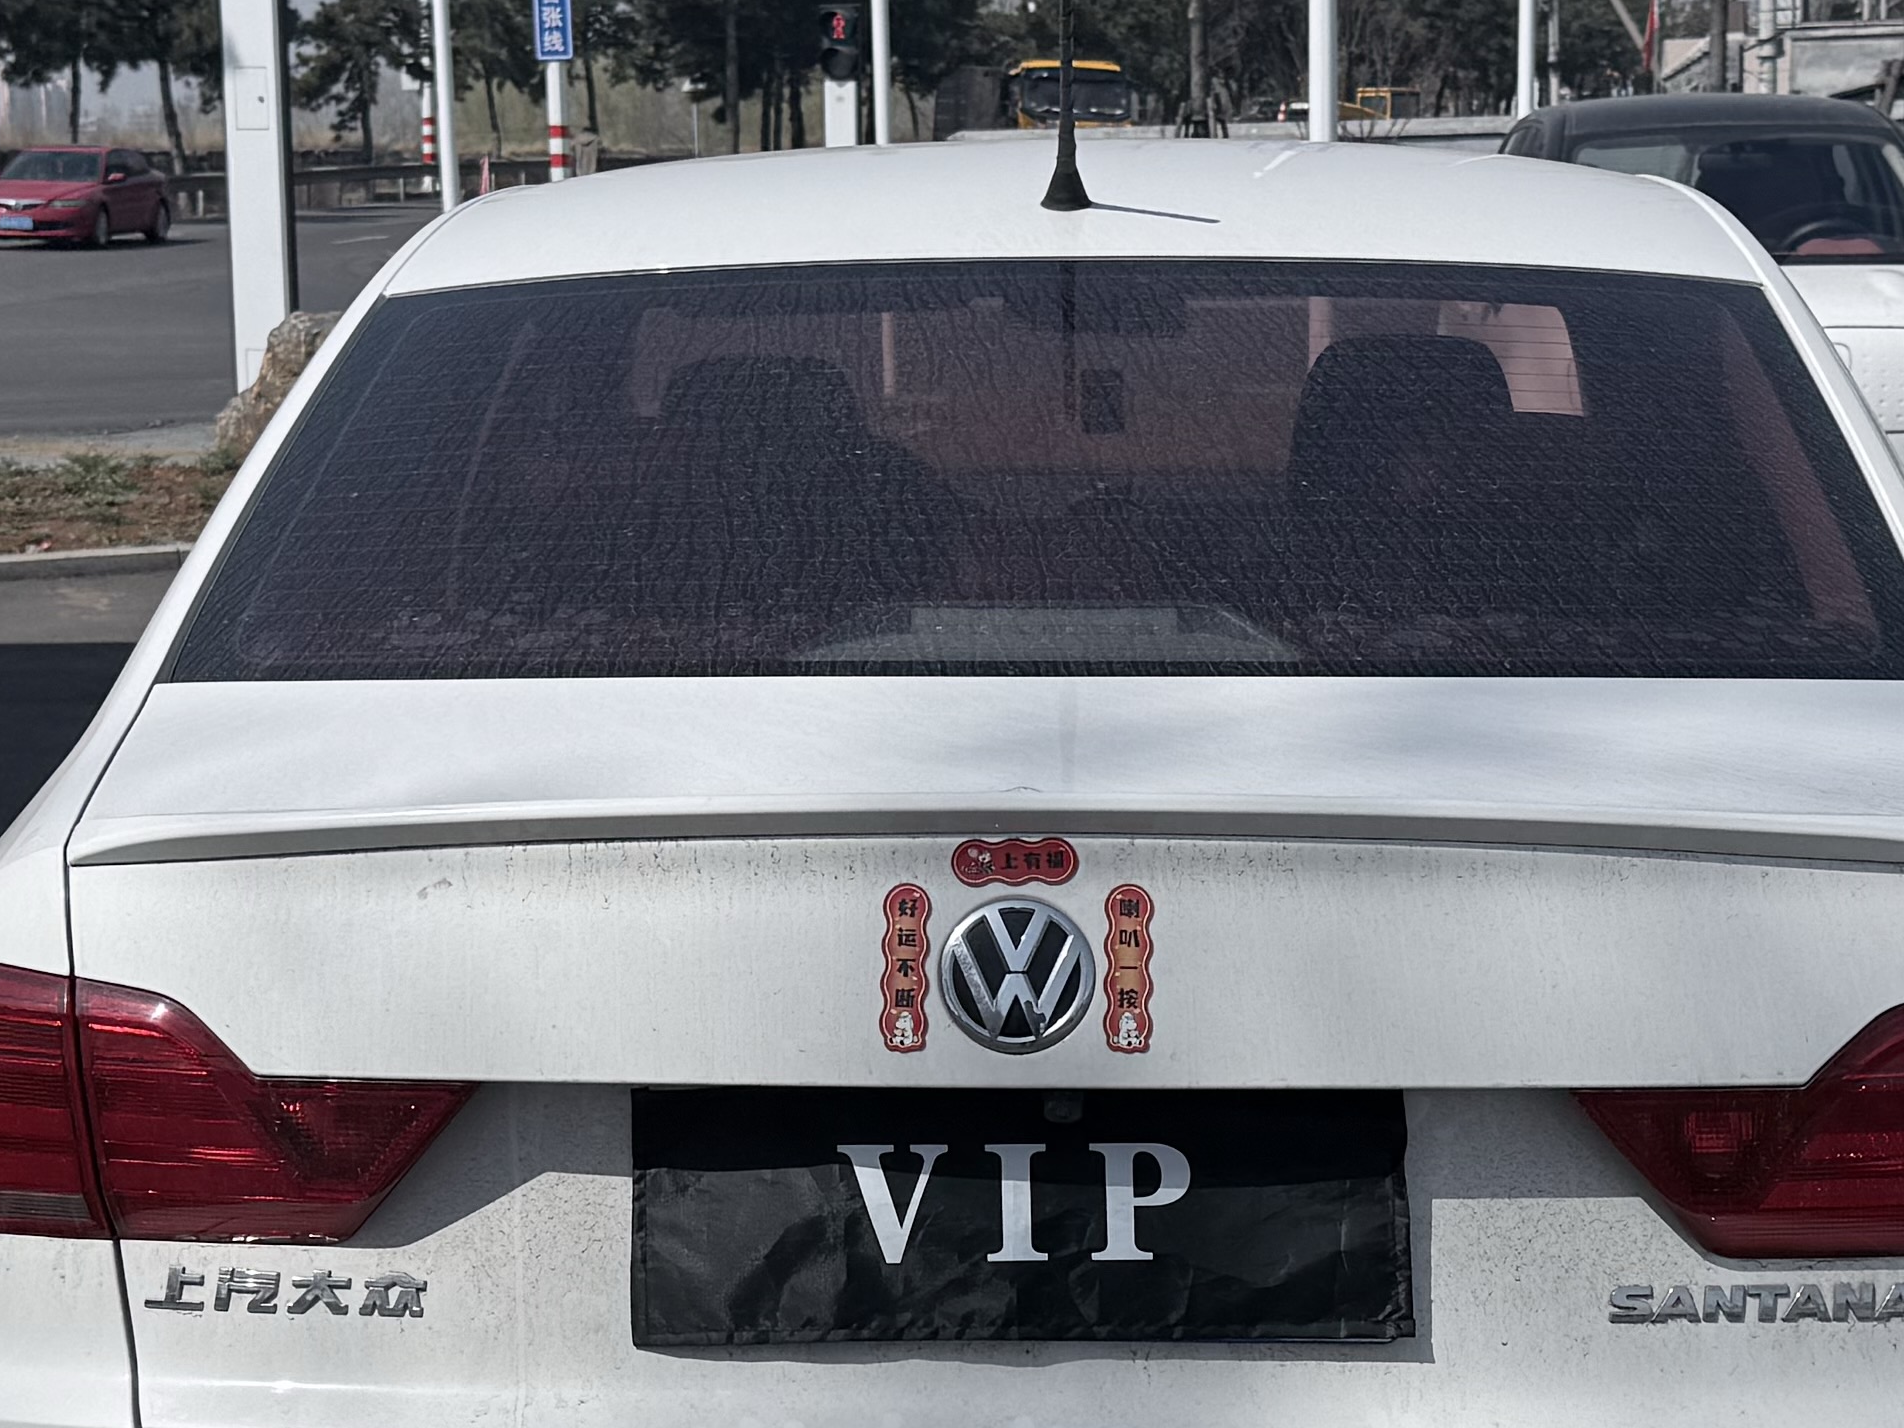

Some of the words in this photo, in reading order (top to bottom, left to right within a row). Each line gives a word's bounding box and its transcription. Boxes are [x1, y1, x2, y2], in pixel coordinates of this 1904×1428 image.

[895, 898, 919, 1009] 好运不断
[1118, 899, 1140, 1009] 喇叭一按
[836, 1142, 1193, 1263] VIP
[144, 1264, 428, 1318] 上汽大众
